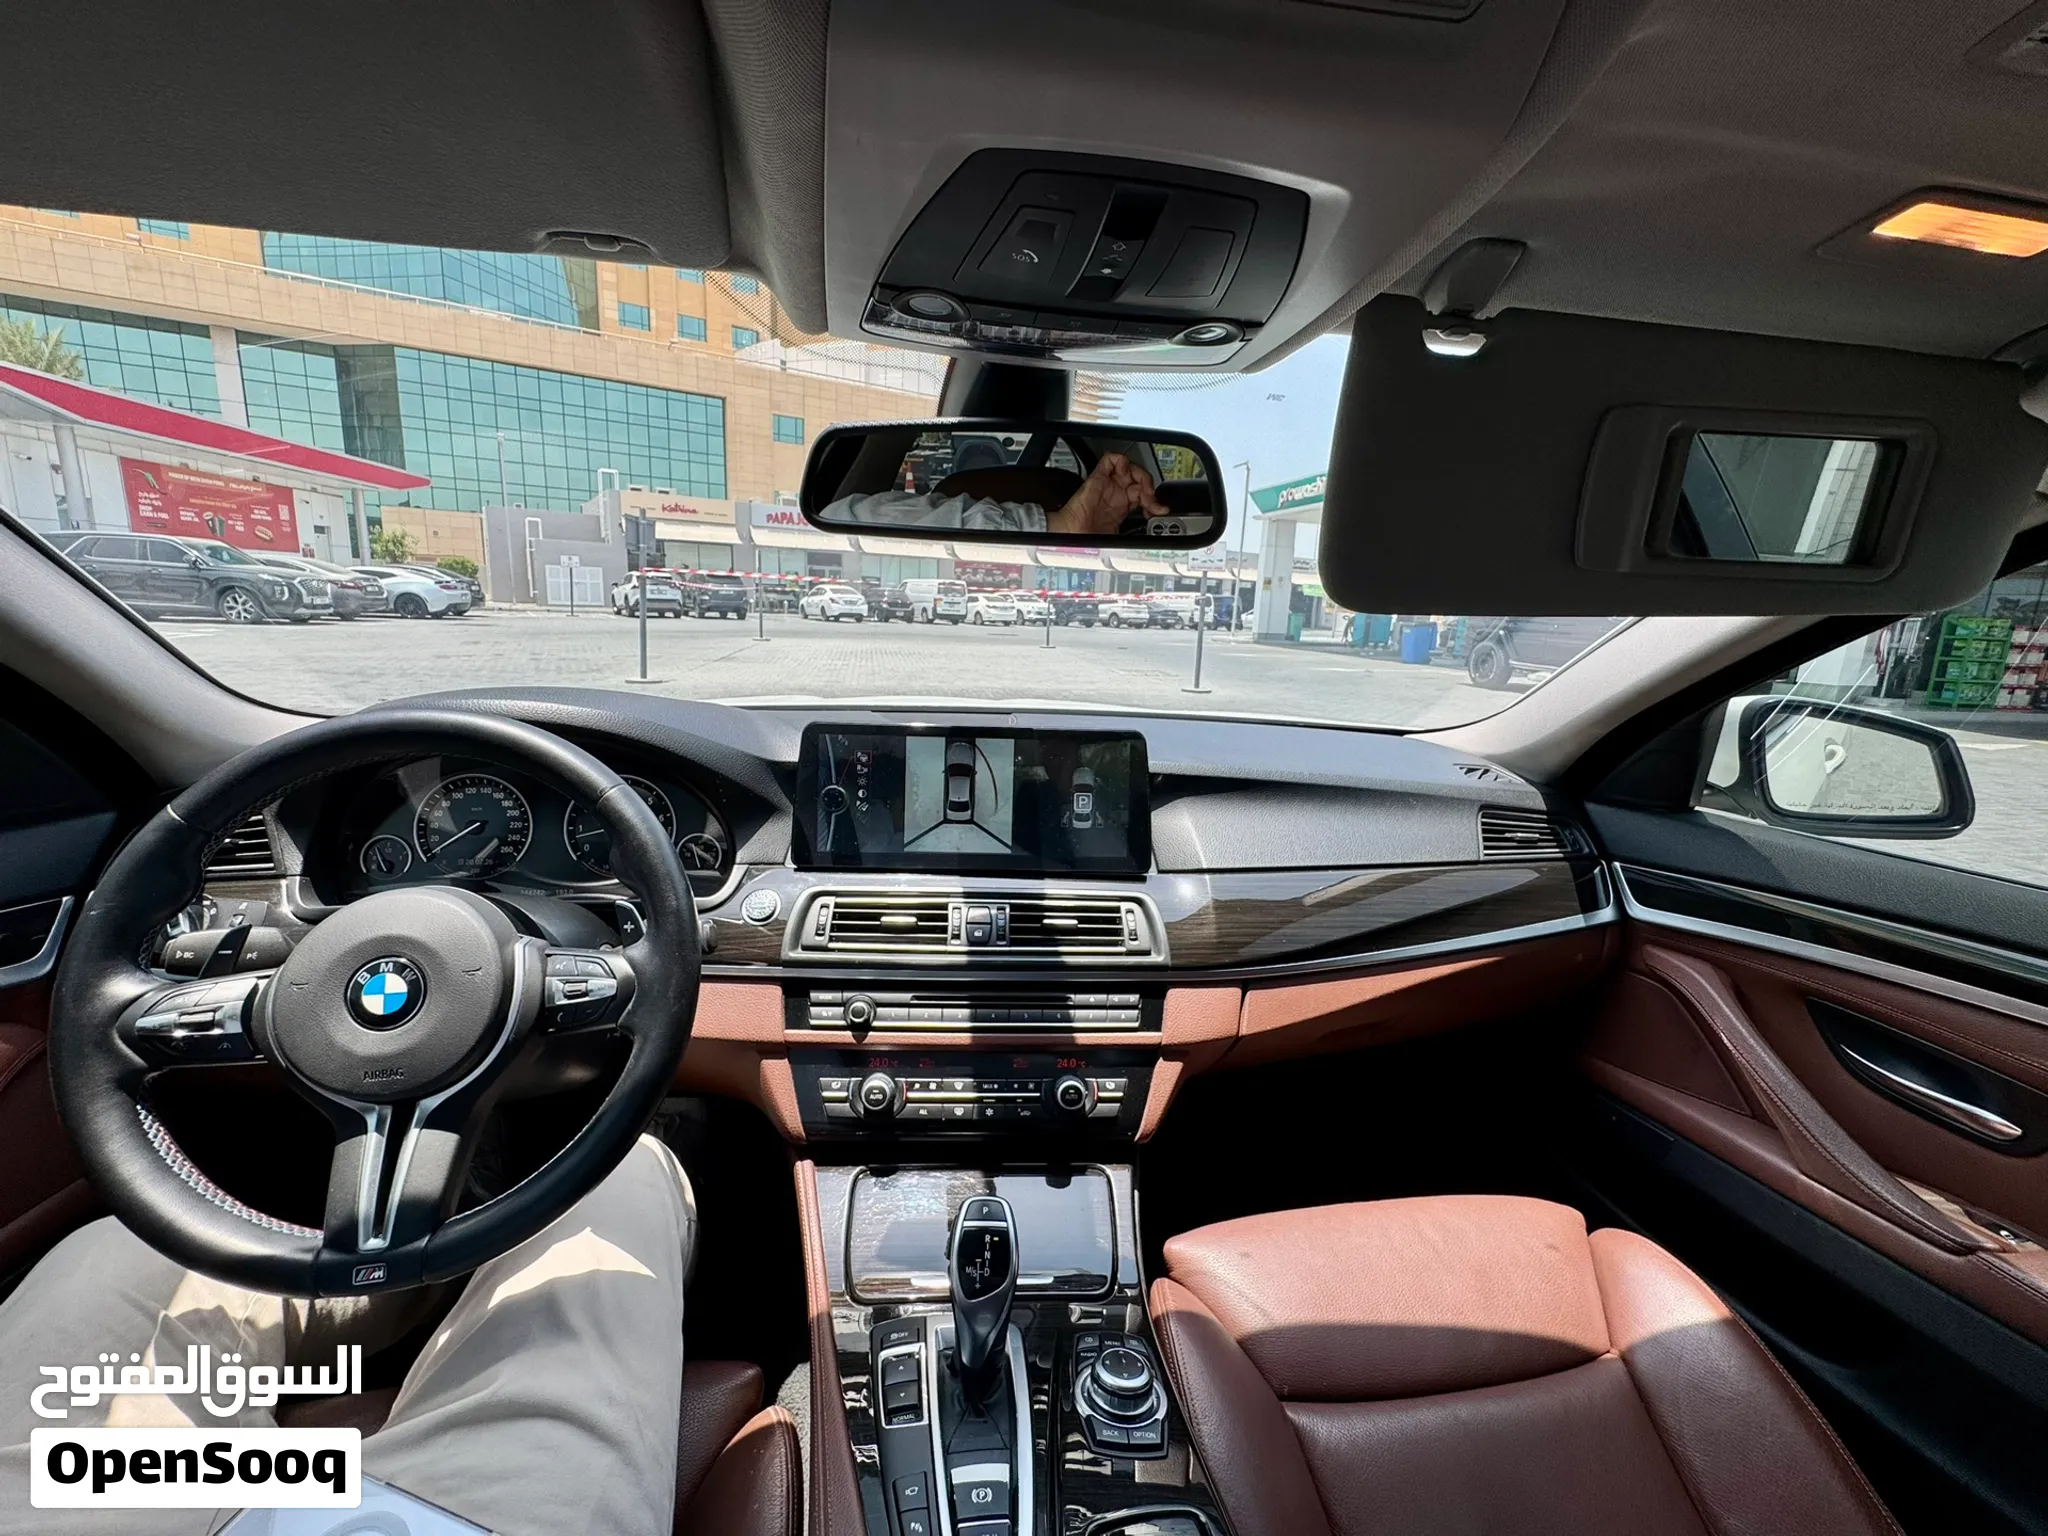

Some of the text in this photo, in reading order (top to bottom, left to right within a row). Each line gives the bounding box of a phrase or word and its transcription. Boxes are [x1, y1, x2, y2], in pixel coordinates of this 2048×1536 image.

[1012, 252, 1030, 263] SOS
[661, 502, 699, 515] Katrina
[766, 512, 795, 525] PAPA
[1079, 796, 1088, 808] P
[506, 809, 520, 817] 200
[357, 962, 417, 985] BMW
[869, 1058, 889, 1067] 24.0
[1057, 1058, 1076, 1068] 24.0
[363, 1068, 404, 1082] AIRBAG
[985, 1234, 991, 1242] R
[985, 1251, 991, 1259] N
[984, 1268, 990, 1276] D
[892, 1413, 915, 1422] NORMAL
[1133, 1431, 1156, 1439] OPTION
